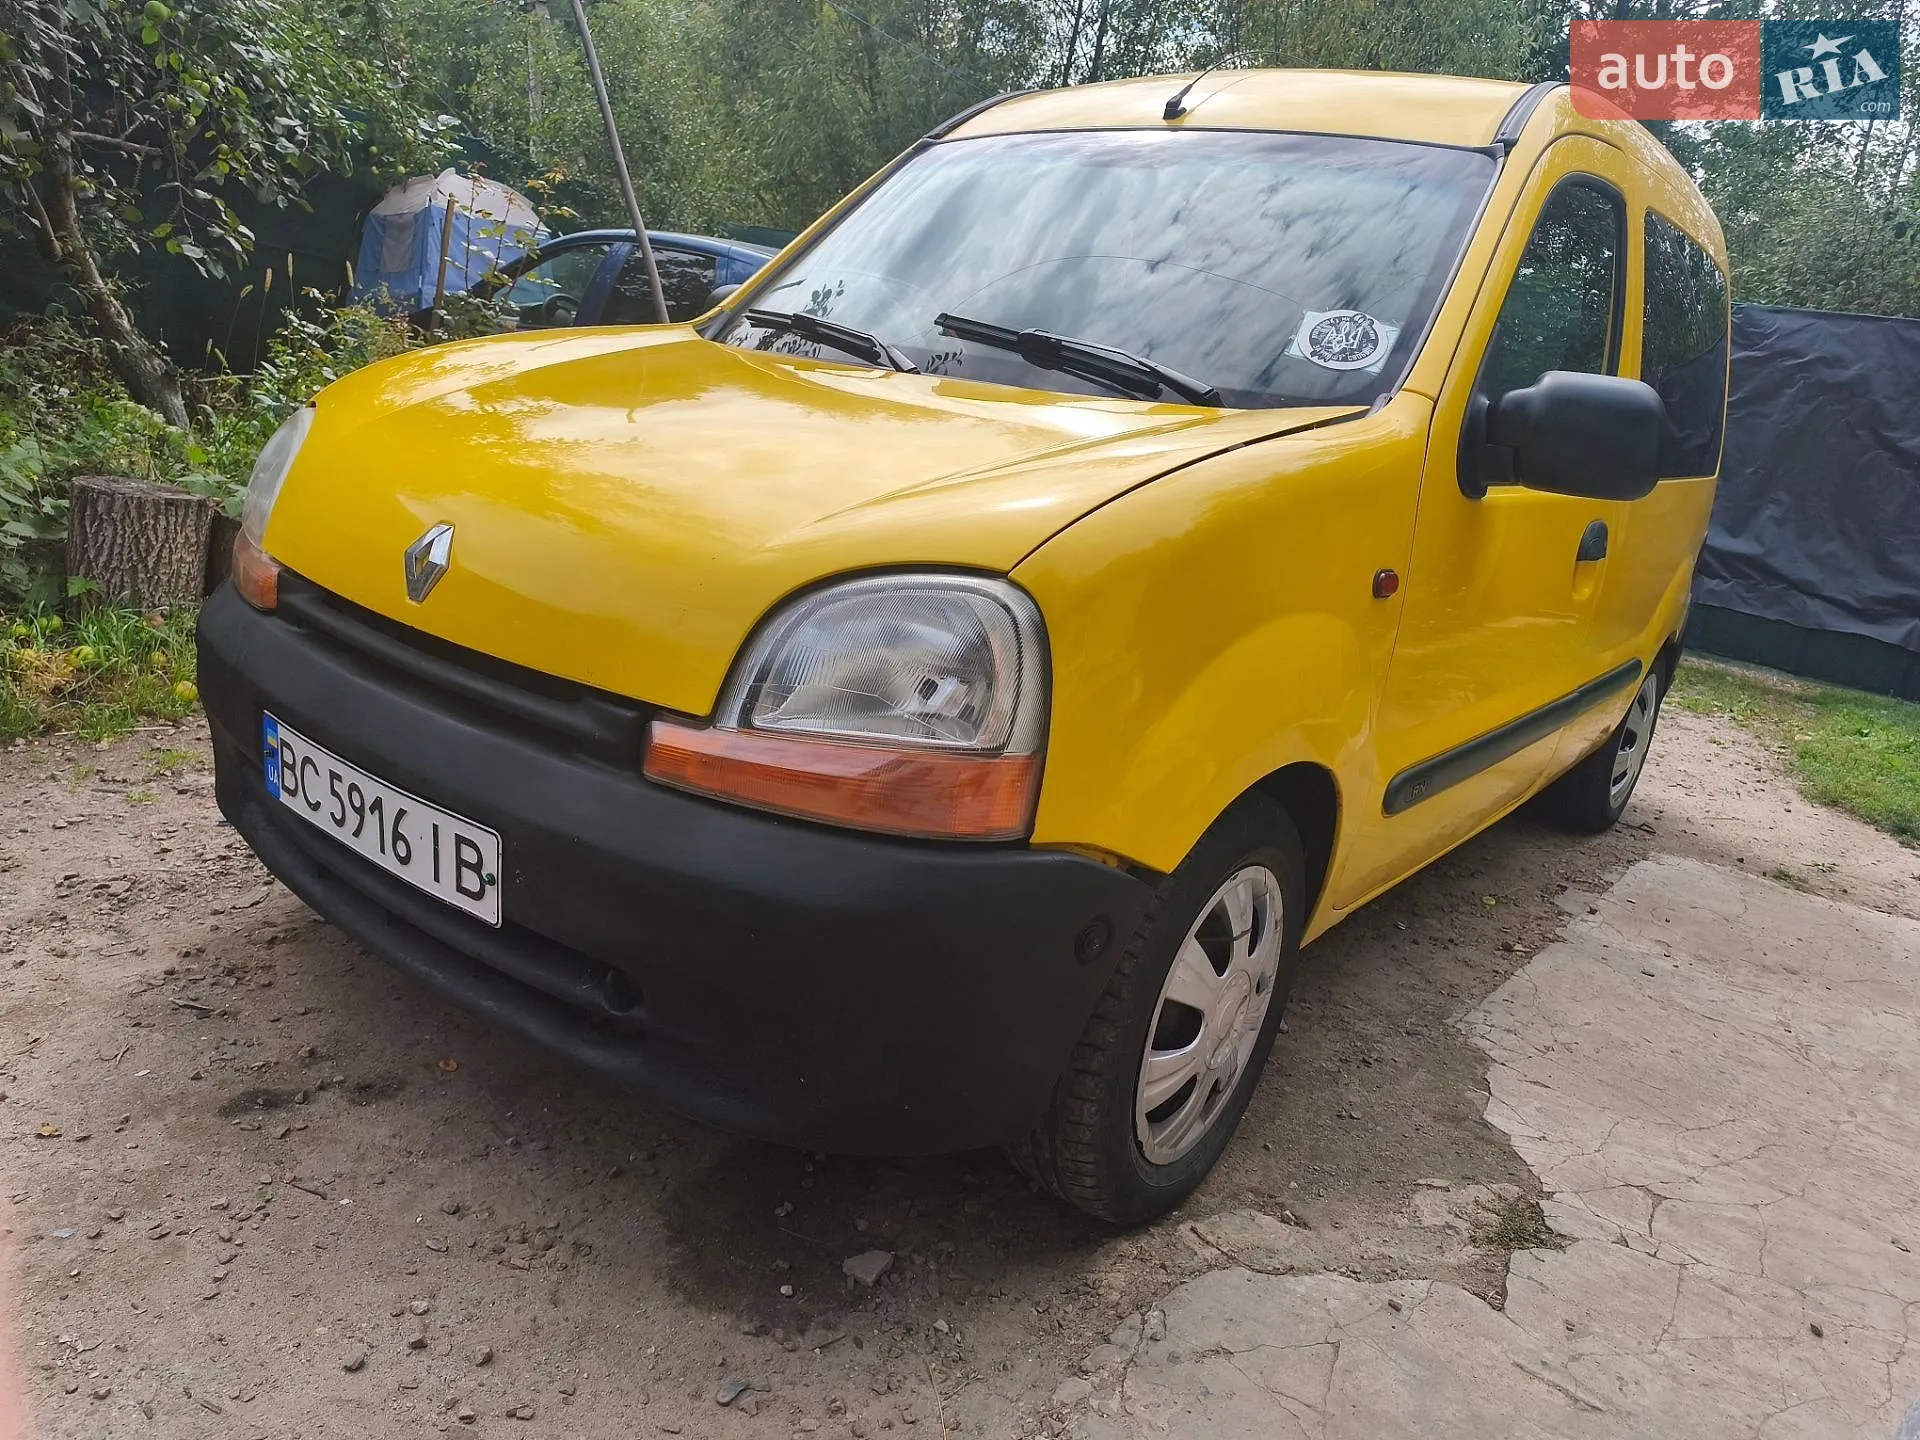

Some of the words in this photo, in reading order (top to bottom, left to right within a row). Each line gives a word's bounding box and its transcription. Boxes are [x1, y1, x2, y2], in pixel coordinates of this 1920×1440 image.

[268, 764, 279, 786] UA
[280, 737, 322, 812] BC
[328, 768, 412, 866] 5916
[432, 822, 486, 901] IB
